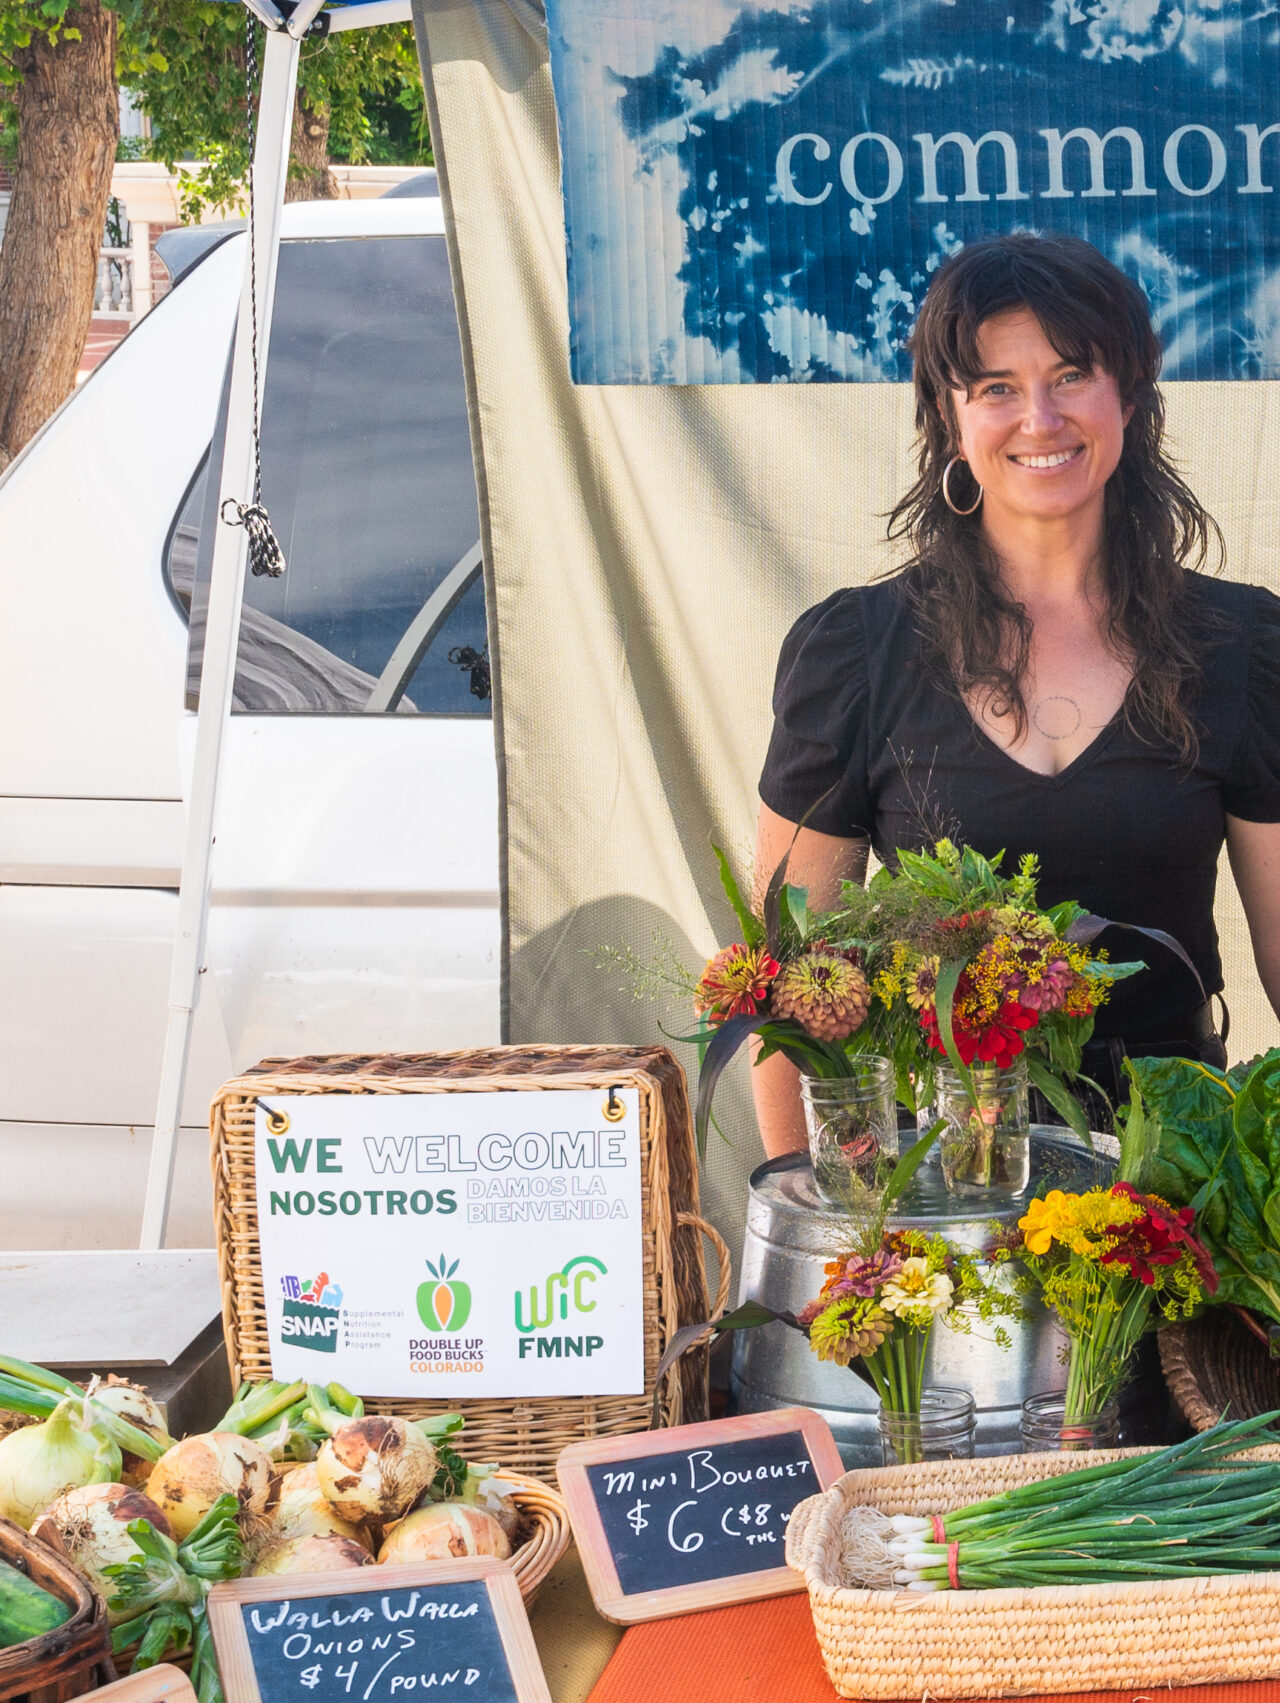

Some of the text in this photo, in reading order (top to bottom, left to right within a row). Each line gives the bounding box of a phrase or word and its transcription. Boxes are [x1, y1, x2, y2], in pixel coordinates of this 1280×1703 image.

[266, 1130, 627, 1173] WE WELCOME
[270, 1175, 607, 1215] NOSOTROS DAMOS LA
[466, 1199, 628, 1223] BIENVENIDA
[343, 1310, 404, 1319] Supplemental
[281, 1315, 339, 1337] SNAP
[343, 1320, 382, 1328] Nutrition
[344, 1330, 391, 1338] Assistance
[345, 1341, 382, 1349] Program
[409, 1339, 483, 1349] DOUBLE UP
[518, 1336, 604, 1358] FMNP
[409, 1350, 484, 1360] FOOD BUCKS
[409, 1361, 484, 1373] COLORADO
[603, 1450, 810, 1495] MINI BOUQUET
[745, 1531, 777, 1545] THE
[251, 1592, 479, 1634] WALLA WALLA
[283, 1630, 416, 1659] ONIONS
